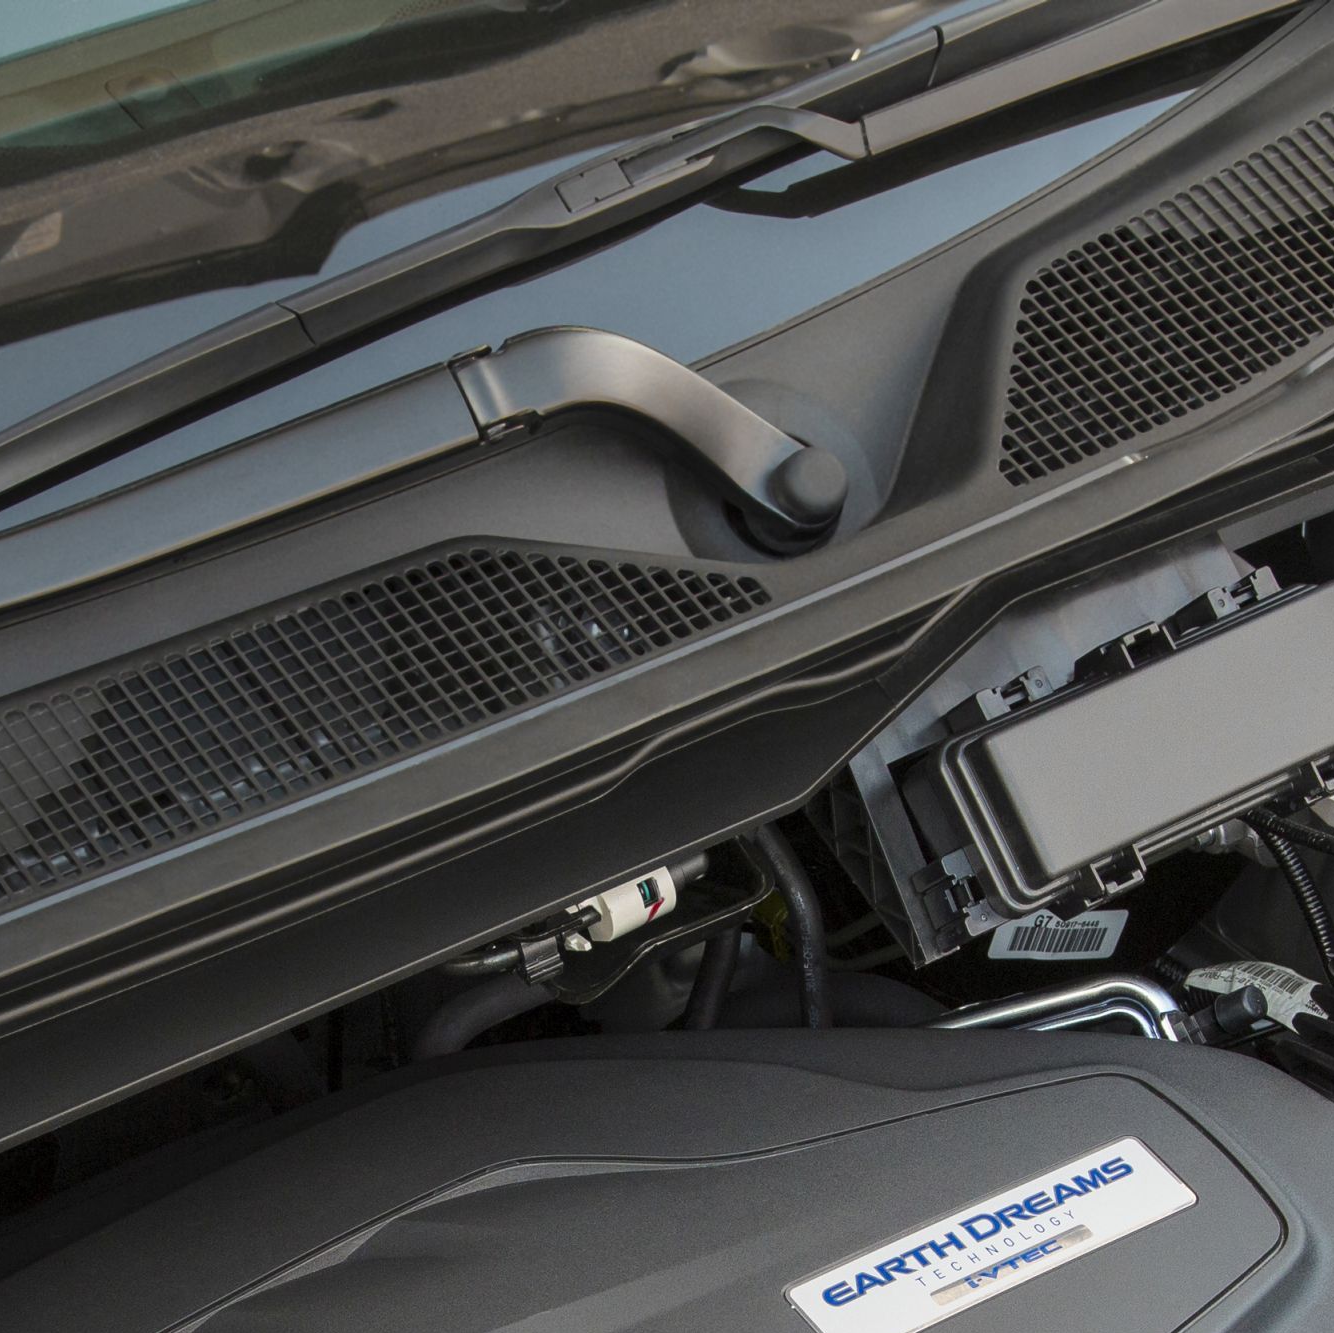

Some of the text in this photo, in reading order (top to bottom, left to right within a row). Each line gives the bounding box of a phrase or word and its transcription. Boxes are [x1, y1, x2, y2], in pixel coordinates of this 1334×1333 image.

[1032, 913, 1054, 928] G7
[822, 1156, 1134, 1307] EARTH DREAMS
[915, 1209, 1077, 1287] TECHNOLOGY
[964, 1238, 1064, 1289] i-VTEC
